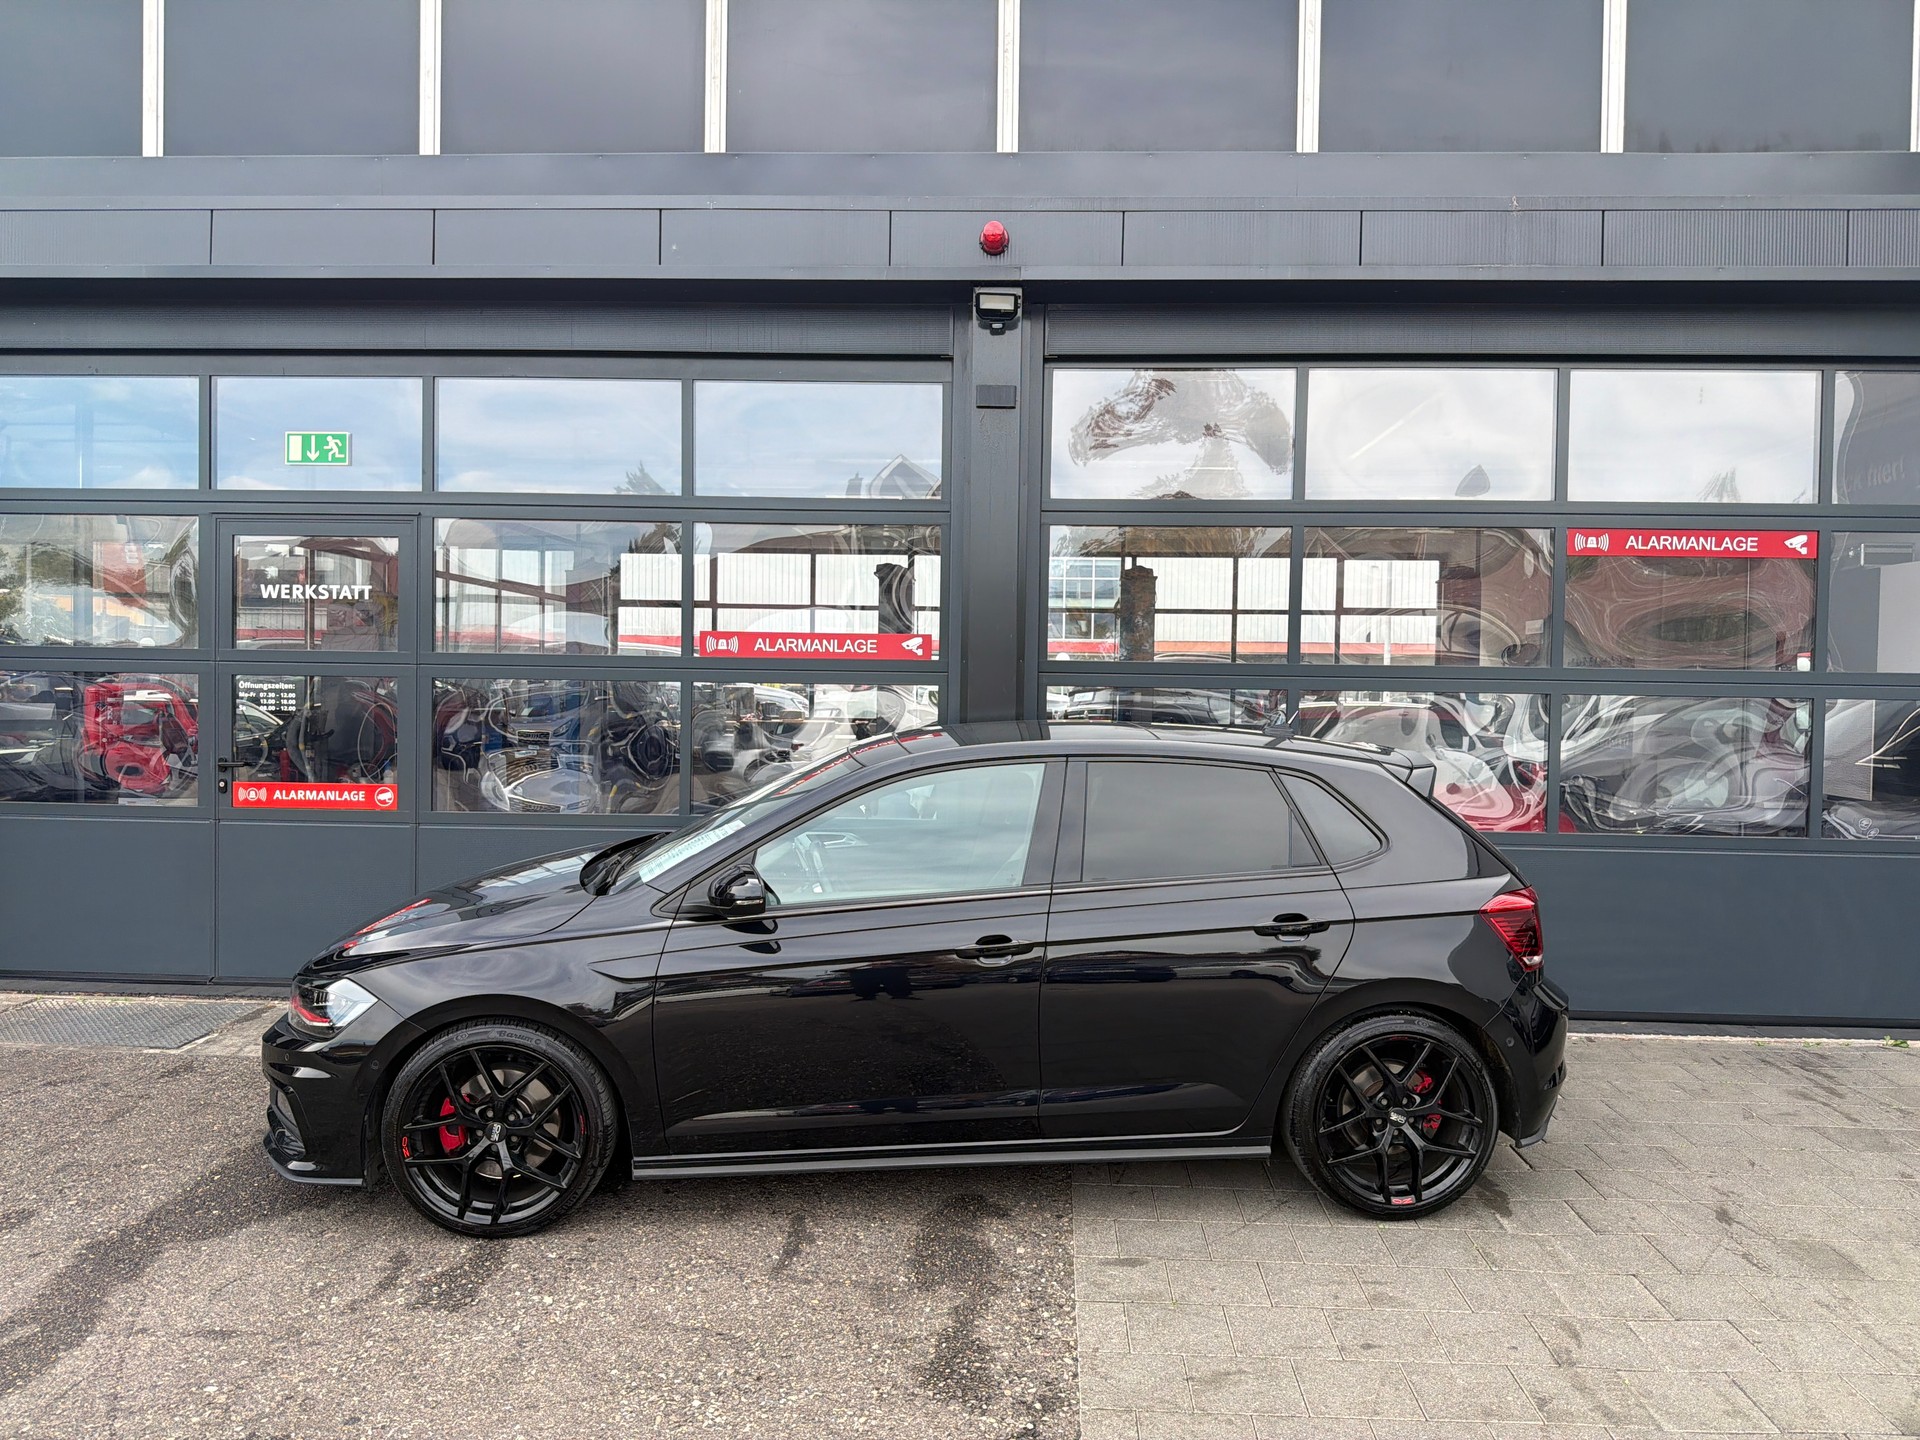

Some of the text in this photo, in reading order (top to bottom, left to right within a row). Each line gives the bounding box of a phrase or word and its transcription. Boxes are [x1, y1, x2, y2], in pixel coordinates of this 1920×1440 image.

[1625, 535, 1758, 552] ALARMANLAGE
[260, 583, 372, 600] WERKSTATT
[754, 638, 877, 653] ALARMANLAGE
[239, 681, 295, 690] Öffnungszeiten:
[273, 789, 365, 801] ALARMANLAGE
[498, 1030, 535, 1044] Barum
